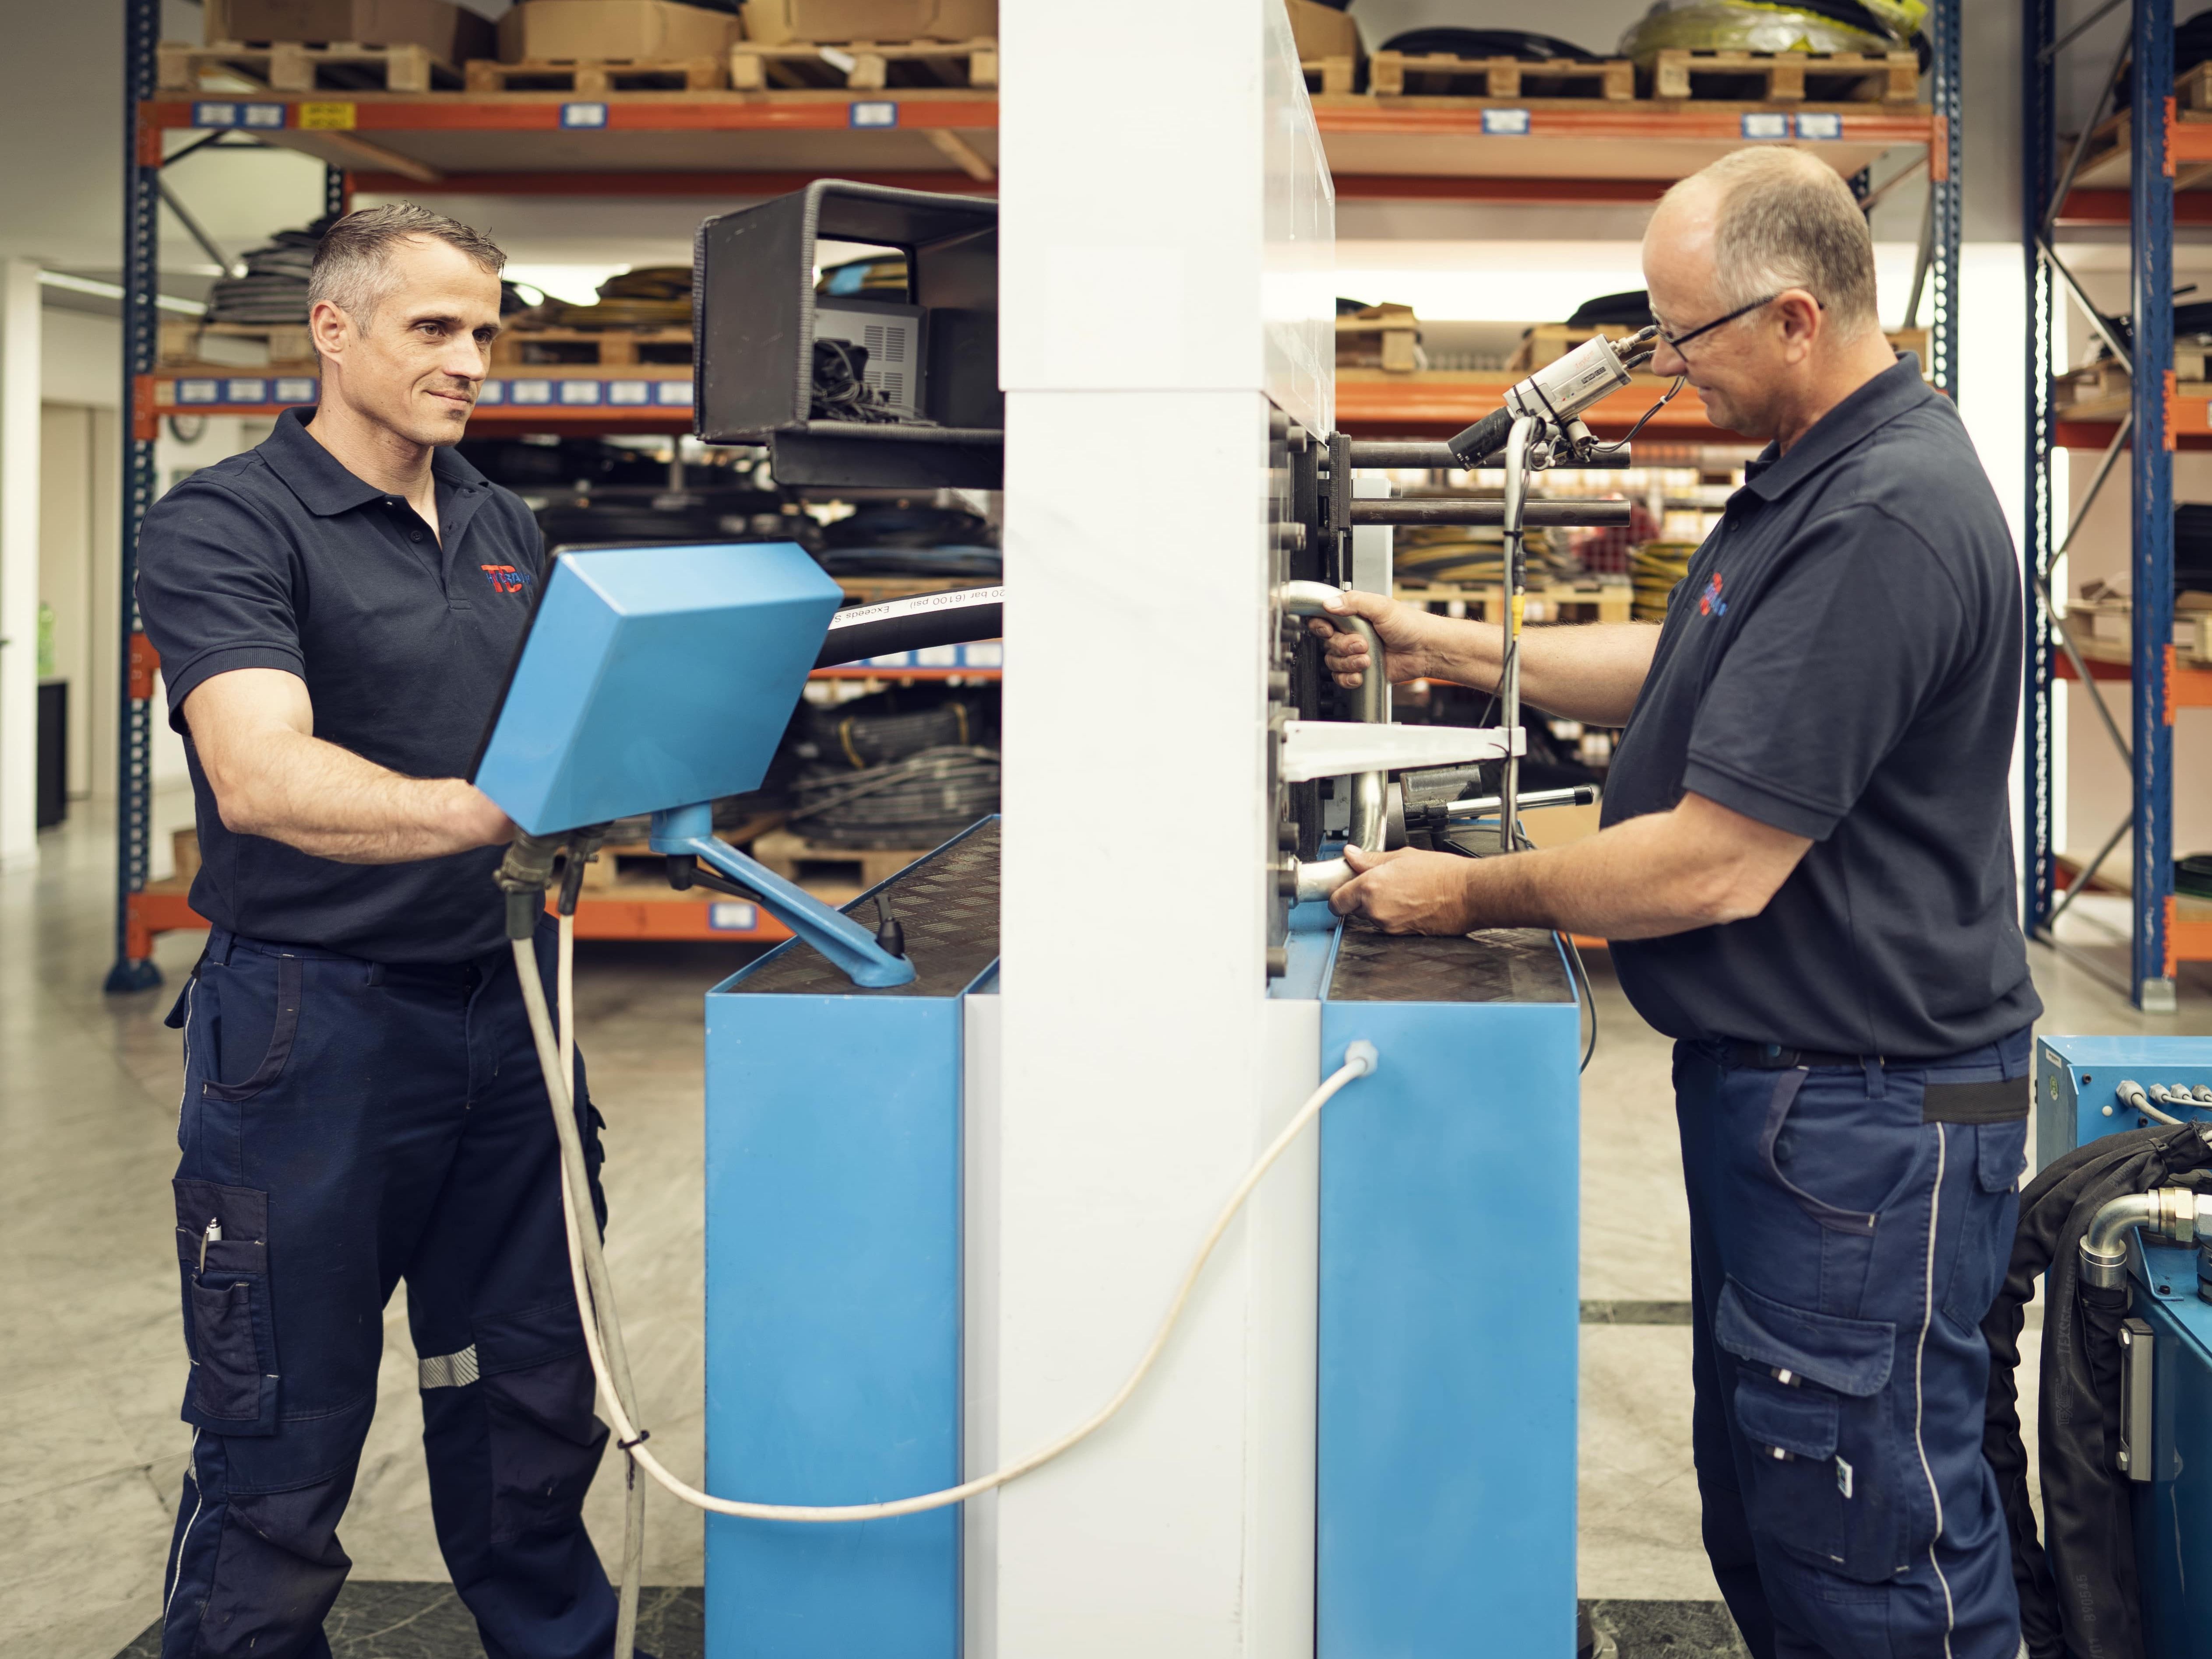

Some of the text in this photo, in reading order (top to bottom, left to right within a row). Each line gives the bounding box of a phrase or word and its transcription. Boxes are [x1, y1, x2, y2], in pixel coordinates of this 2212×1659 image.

[481, 564, 522, 593] TC
[910, 599, 929, 609] psi)
[933, 594, 965, 605] (6100
[846, 606, 889, 619] Exceeds
[2077, 1575, 2096, 1620] B90545
